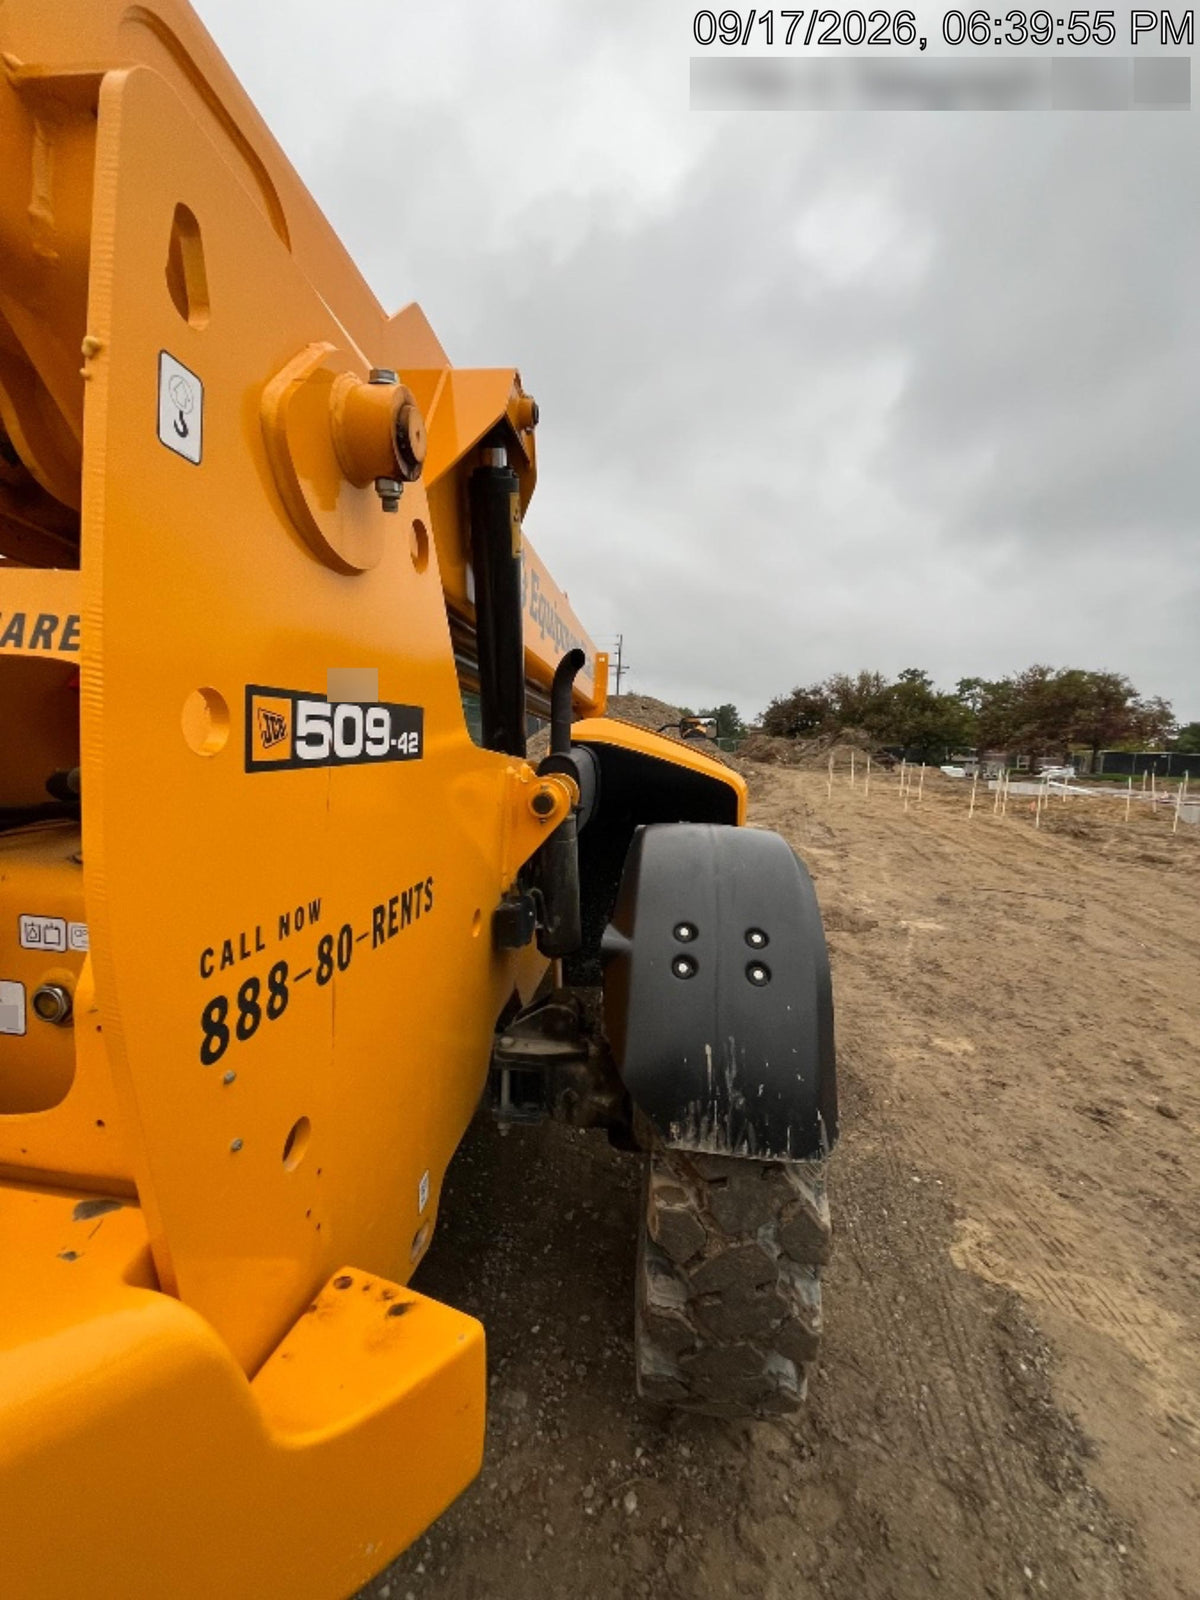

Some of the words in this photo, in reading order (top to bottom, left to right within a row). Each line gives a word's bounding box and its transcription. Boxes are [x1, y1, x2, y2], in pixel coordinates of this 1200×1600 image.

[0, 612, 80, 651] ARE
[200, 926, 265, 989] CALL
[278, 898, 321, 941] NOW
[200, 876, 433, 1066] 888-80-RENTS
